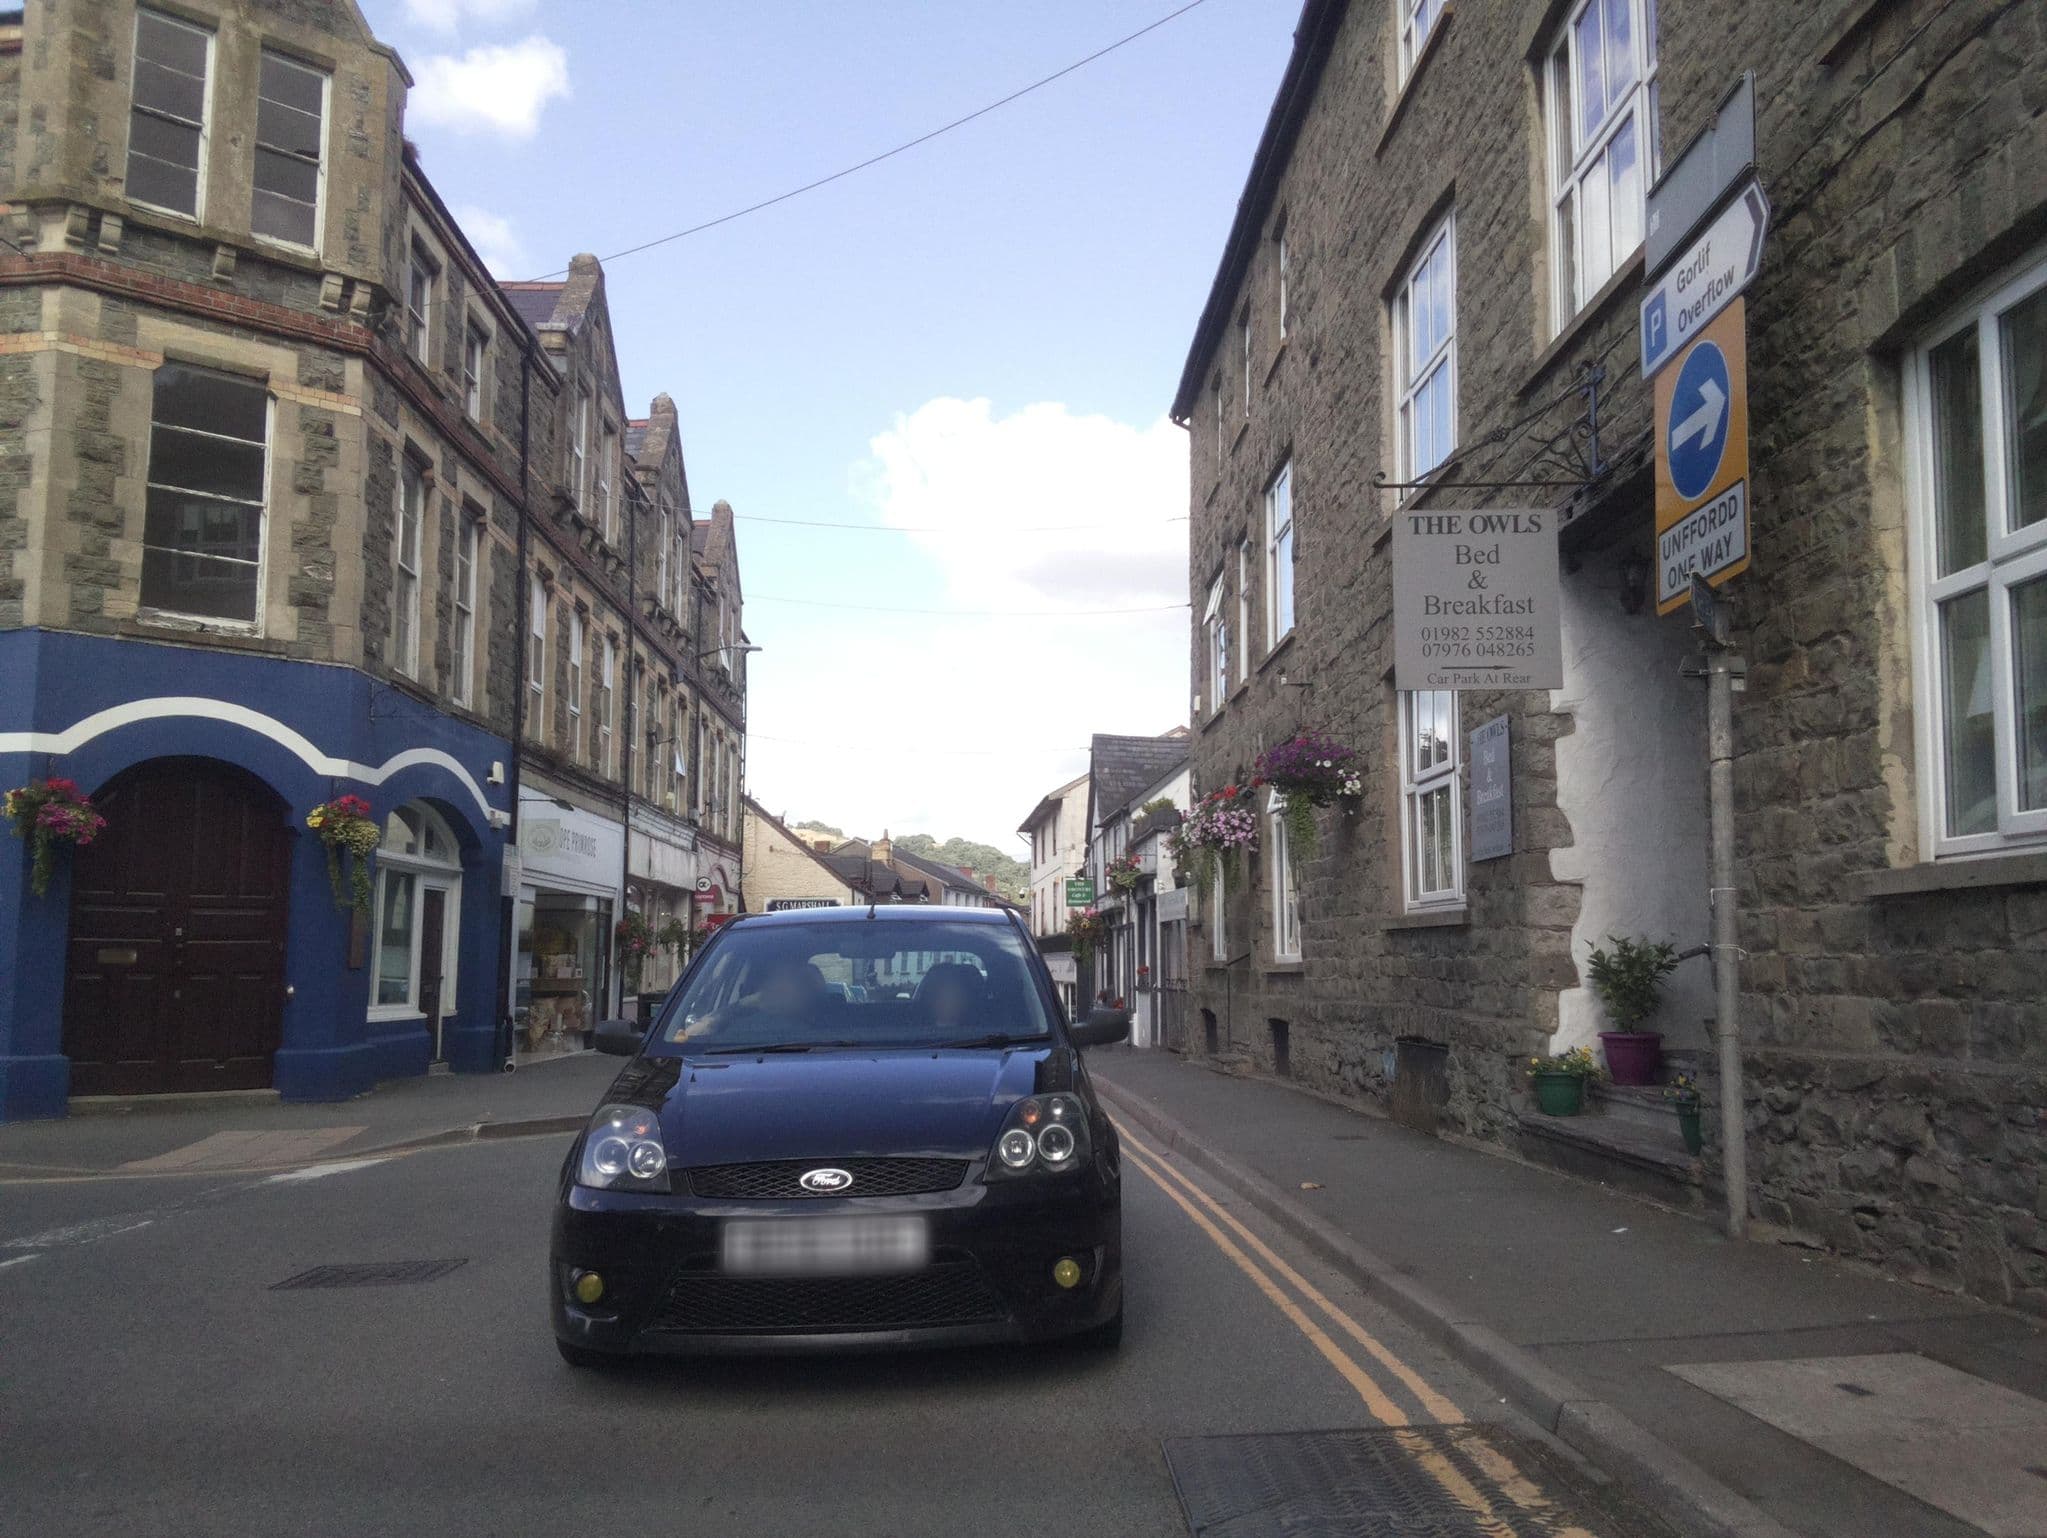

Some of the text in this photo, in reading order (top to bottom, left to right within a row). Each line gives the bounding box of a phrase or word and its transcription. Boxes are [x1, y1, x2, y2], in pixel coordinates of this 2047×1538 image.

[1676, 240, 1711, 294] Gorlif
[1678, 265, 1735, 333] Overflow
[1408, 514, 1542, 536] THE OWLS
[1662, 494, 1738, 561] UNFFORDD
[1455, 543, 1501, 565] Bed
[1700, 531, 1733, 571] WAY
[1467, 569, 1489, 590] &
[1423, 594, 1536, 616] Breakfast
[1421, 626, 1535, 641] 01982 552884
[1422, 642, 1535, 657] 07976 048265
[1427, 673, 1532, 685] Car Park At Rear
[811, 1173, 841, 1186] Ford
